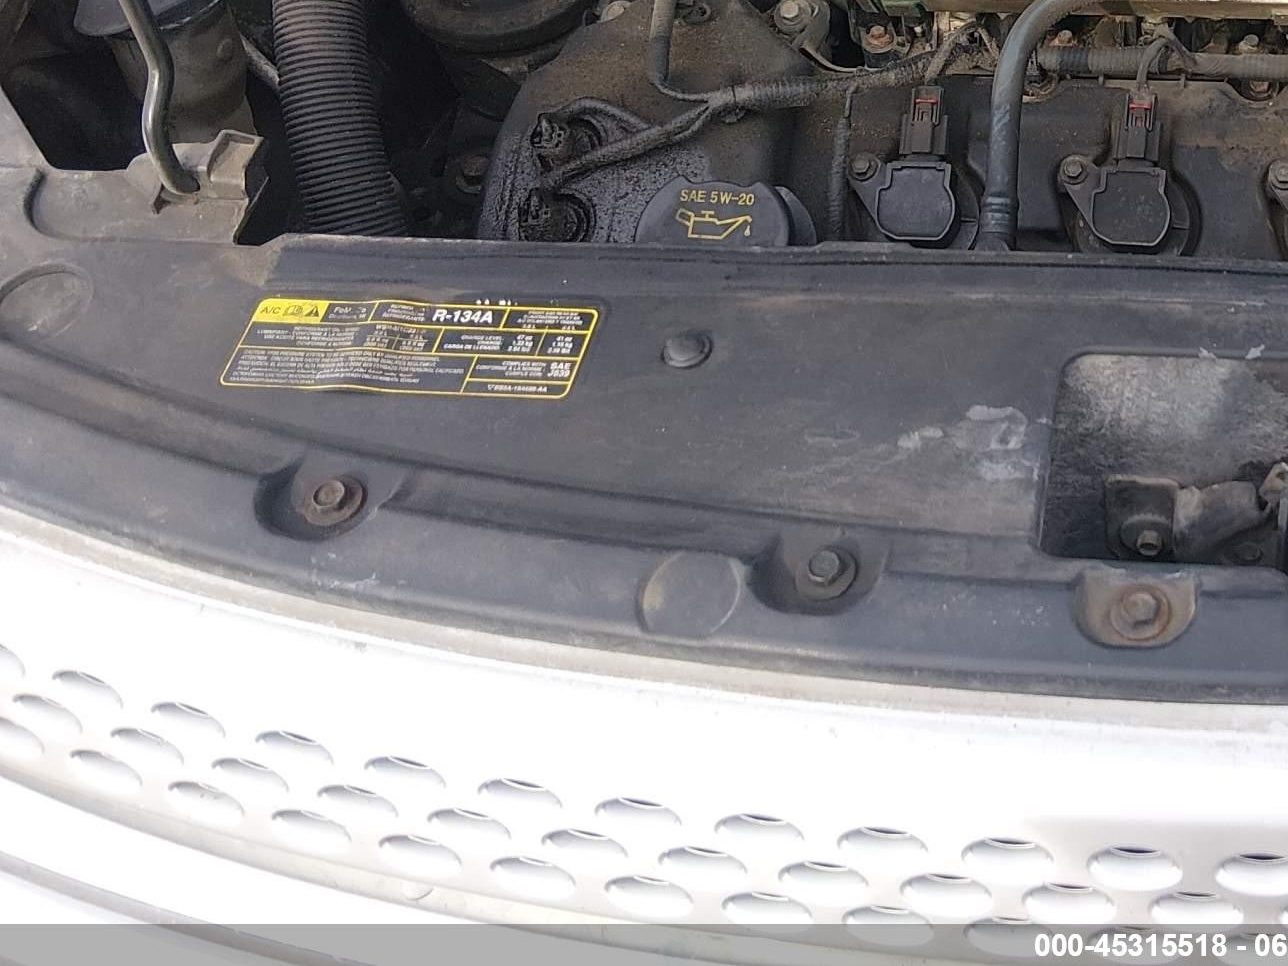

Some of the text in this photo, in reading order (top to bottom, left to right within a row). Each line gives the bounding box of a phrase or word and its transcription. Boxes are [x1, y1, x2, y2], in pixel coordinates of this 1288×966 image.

[680, 189, 755, 206] SAE 5W-20
[260, 306, 281, 314] A/C
[432, 309, 493, 324] R-134A
